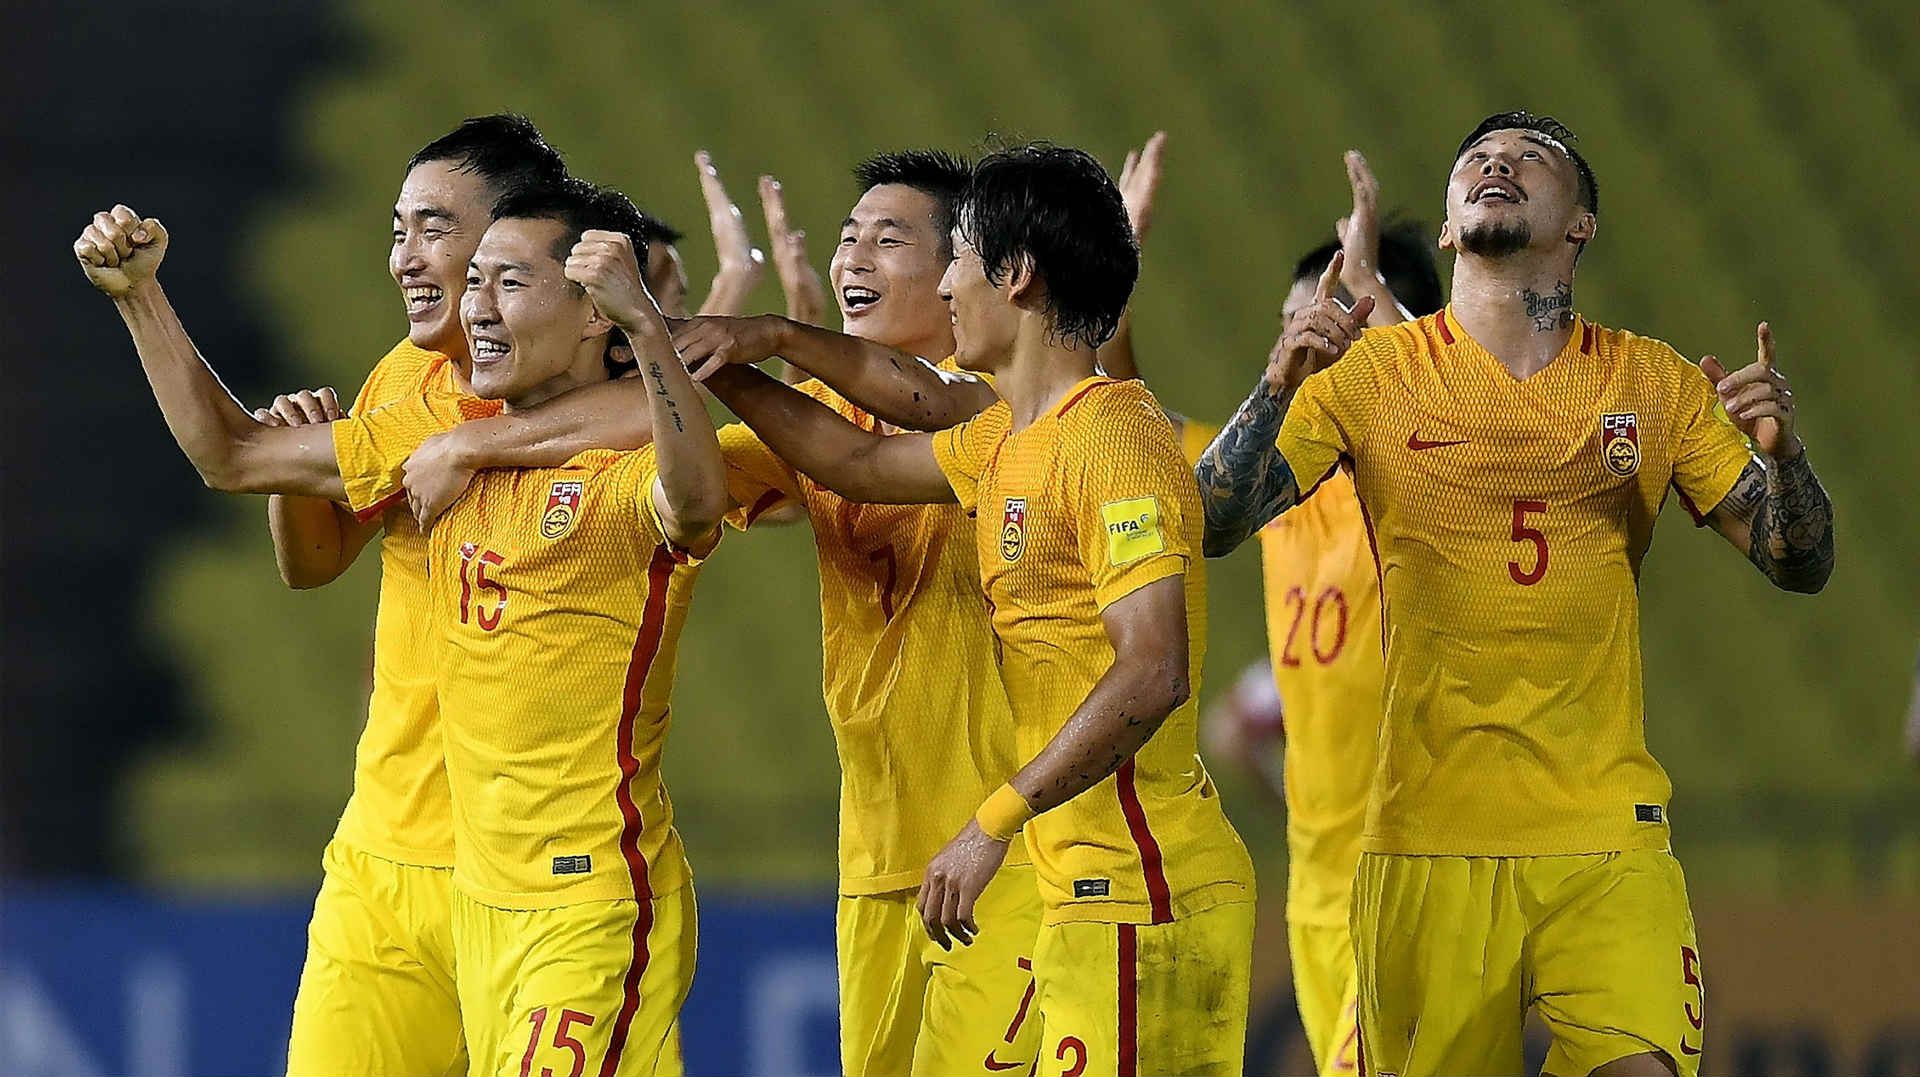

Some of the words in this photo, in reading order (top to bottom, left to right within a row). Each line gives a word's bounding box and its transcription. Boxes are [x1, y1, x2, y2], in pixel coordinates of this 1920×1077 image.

[1605, 415, 1635, 429] CFA
[551, 483, 581, 496] CFA
[1109, 520, 1139, 535] FIFA
[869, 543, 897, 625] 7
[1508, 501, 1548, 586] 5
[460, 544, 507, 631] 15
[1281, 585, 1346, 666] 20
[1681, 946, 1703, 1031] 5
[519, 1006, 596, 1077] 15
